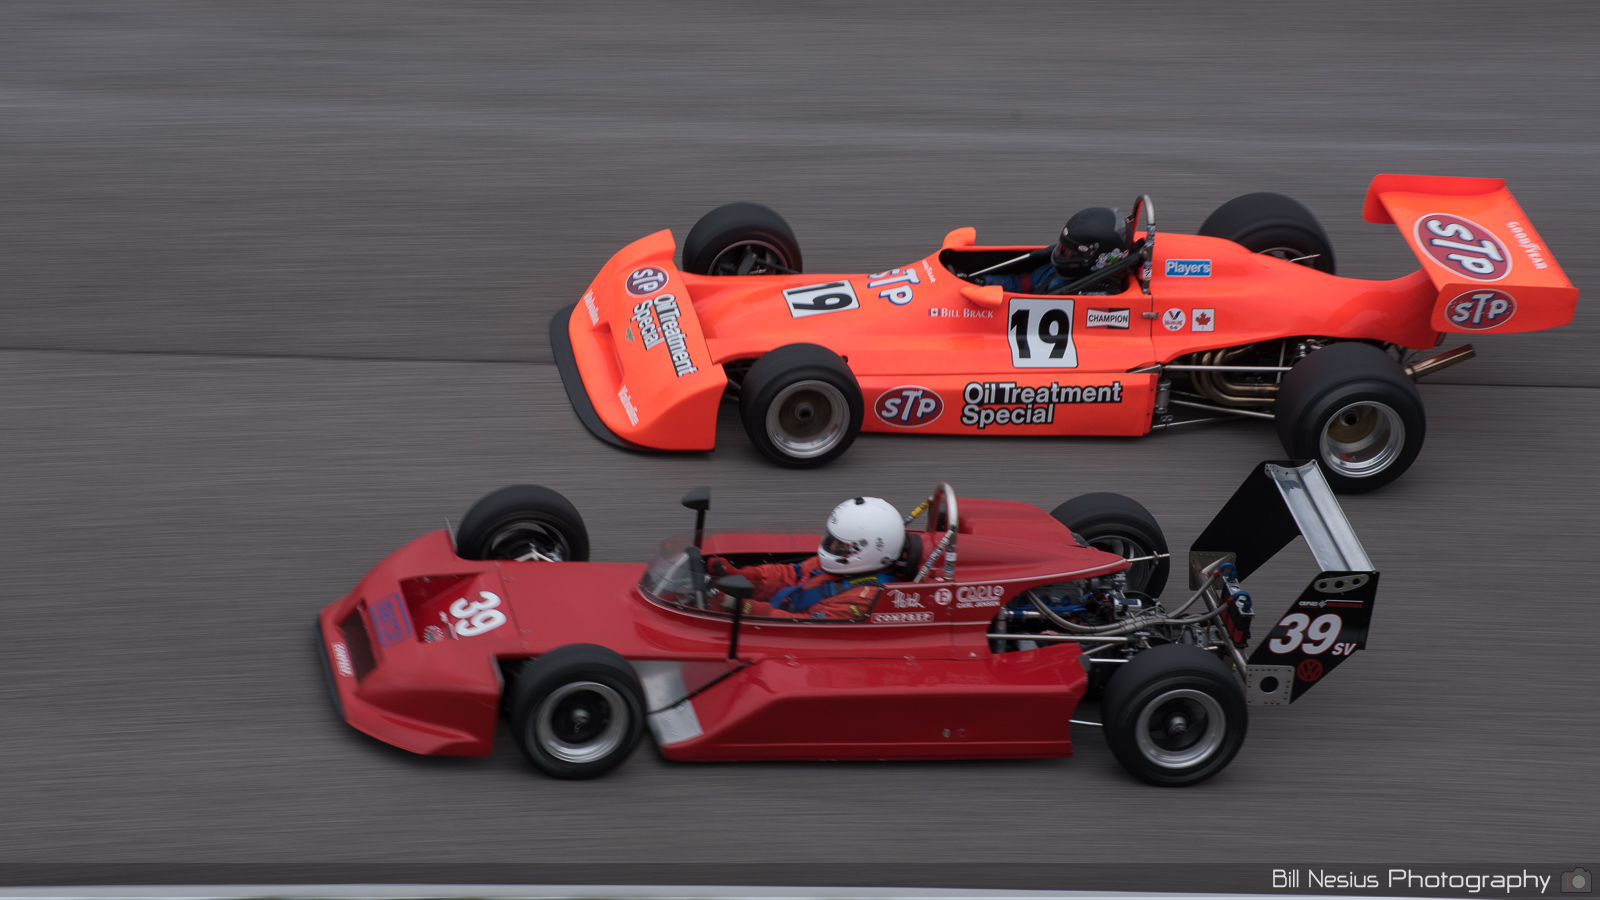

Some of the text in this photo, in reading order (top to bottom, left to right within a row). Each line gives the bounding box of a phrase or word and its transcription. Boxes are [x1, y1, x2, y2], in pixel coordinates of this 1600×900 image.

[1427, 219, 1504, 275] STP
[1506, 221, 1548, 270] GOODYEAR
[631, 268, 666, 293] STP
[866, 268, 921, 306] STP
[1165, 261, 1211, 275] Player's
[582, 289, 600, 327] Valvoline
[787, 281, 853, 313] 19
[1452, 292, 1510, 325] STP
[632, 298, 664, 351] Special
[653, 293, 698, 377] Oil Treatment
[1009, 308, 1071, 360] 19
[1088, 313, 1129, 325] CHAMPION
[617, 384, 640, 426] Valvoline
[881, 389, 937, 423] STP
[965, 382, 1122, 404] Oil Treatment
[962, 403, 1055, 427] Special
[448, 590, 507, 637] 39
[1268, 612, 1357, 656] 39 SV
